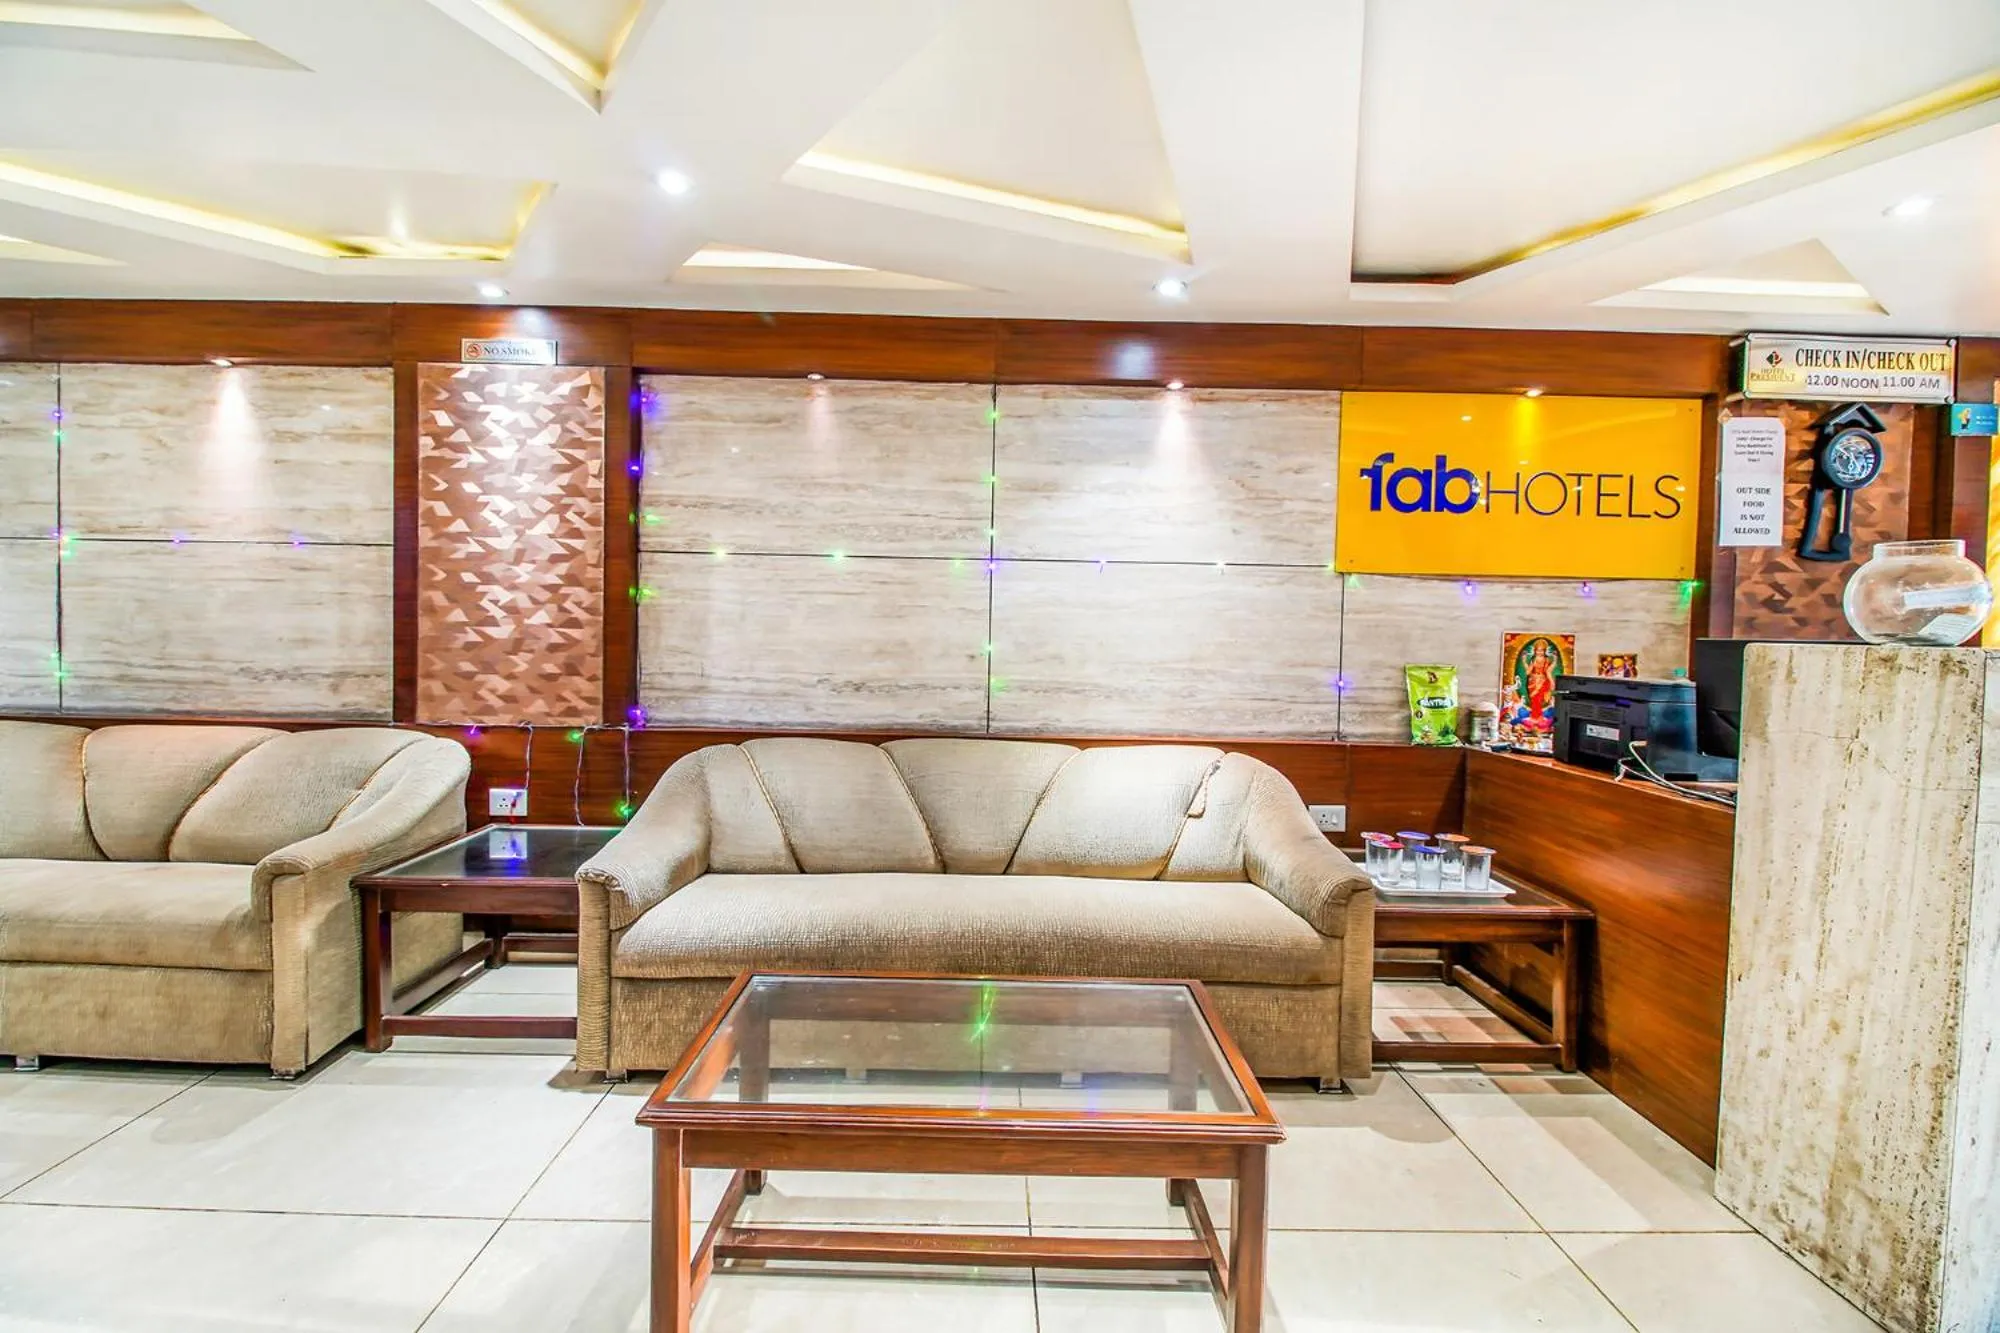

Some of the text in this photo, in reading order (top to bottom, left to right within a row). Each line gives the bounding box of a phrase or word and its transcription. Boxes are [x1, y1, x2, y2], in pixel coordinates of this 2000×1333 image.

[483, 345, 500, 355] NO
[1795, 348, 1947, 371] CHECK IN/CHECK OUT
[1807, 375, 1941, 389] 12.00 NOON 11.00 AM
[1754, 487, 1771, 495] SIDE
[1733, 527, 1771, 535] ALLOWED
